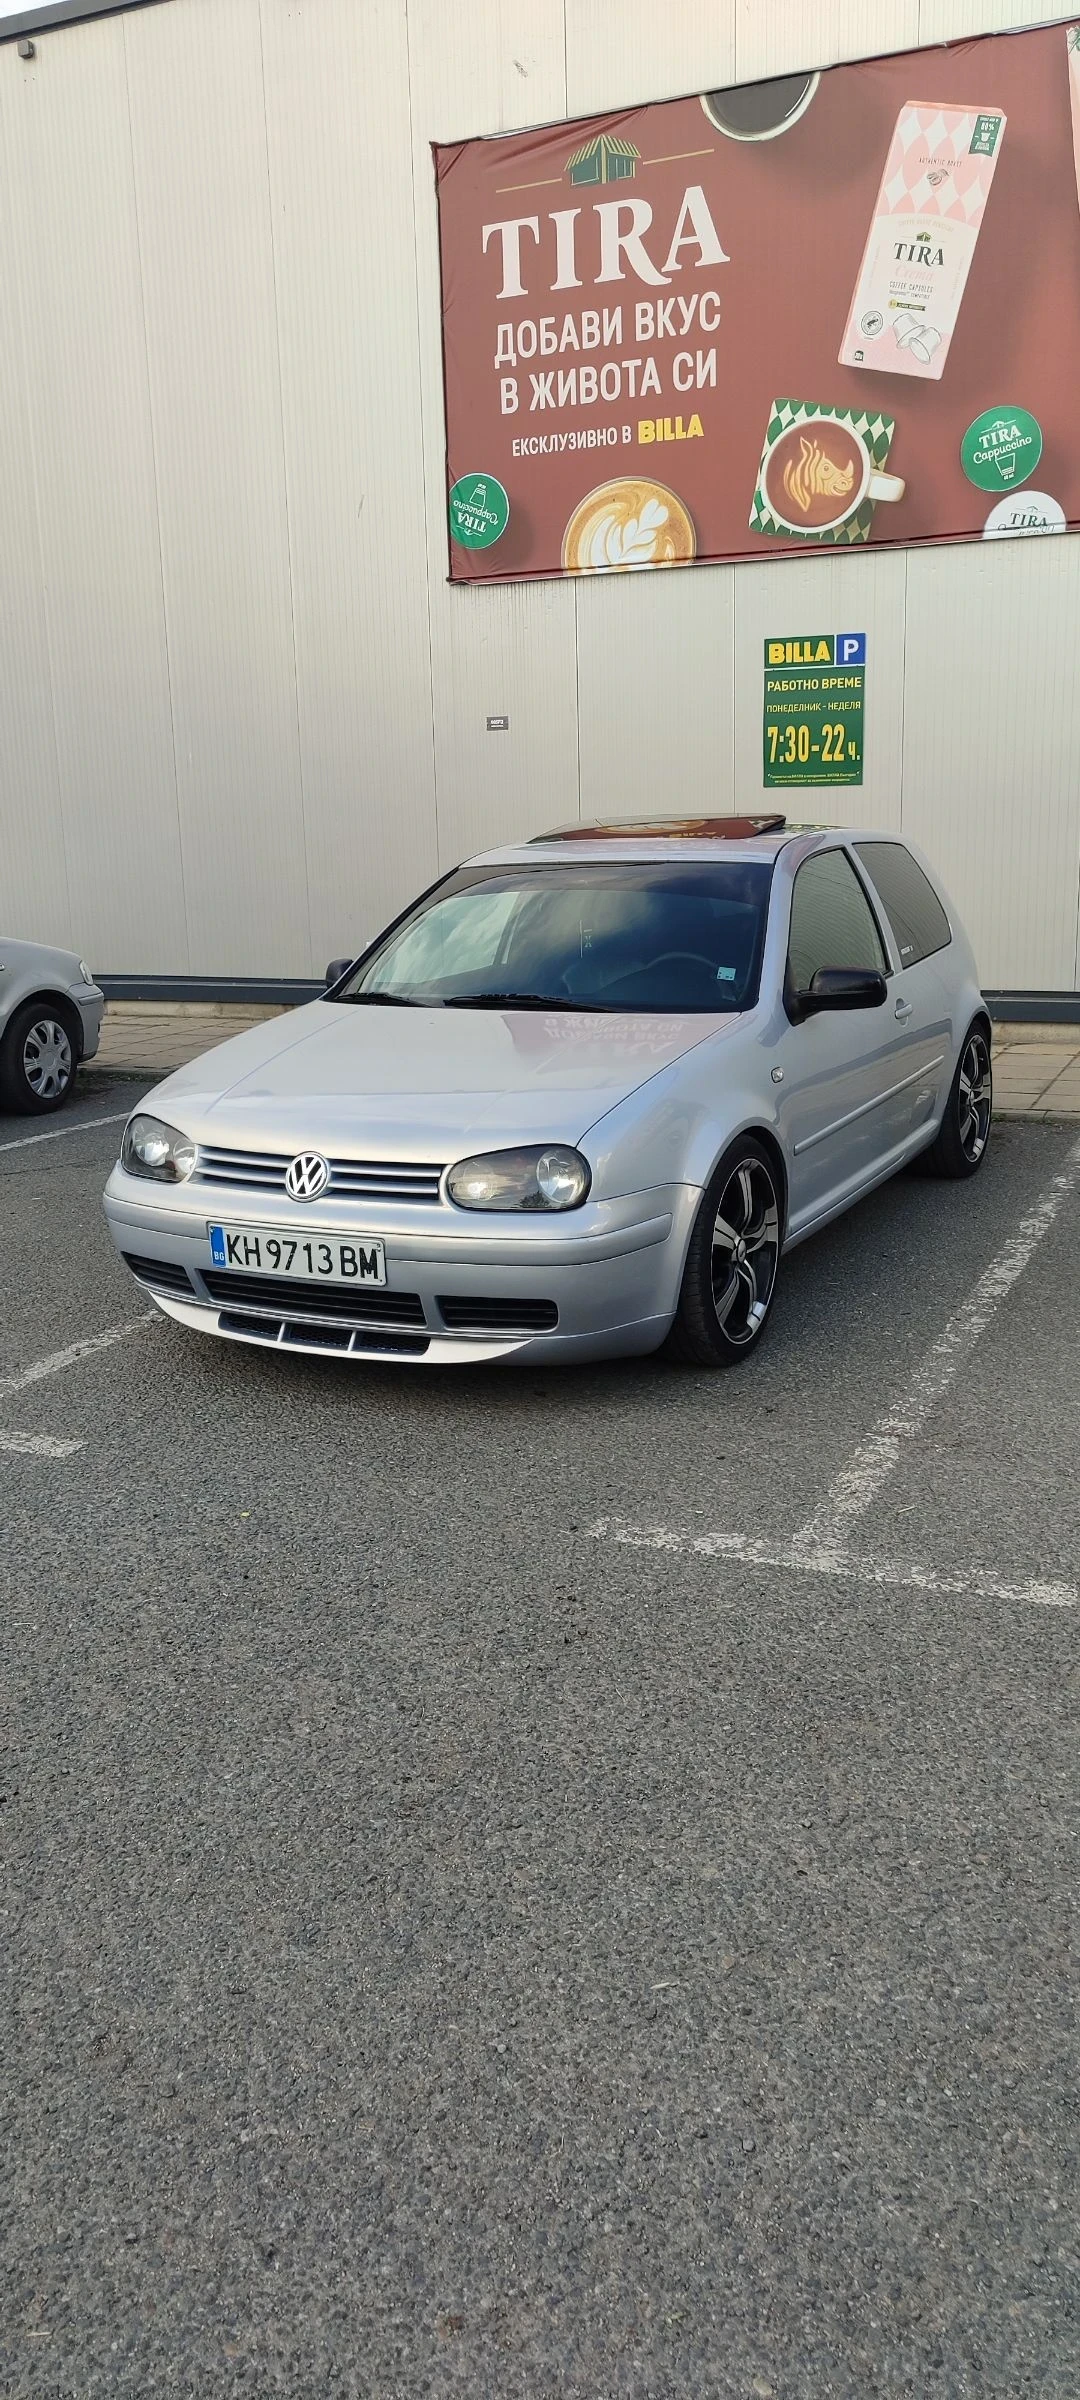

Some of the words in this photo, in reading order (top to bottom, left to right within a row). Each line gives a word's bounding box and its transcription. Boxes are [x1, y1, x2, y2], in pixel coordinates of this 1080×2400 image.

[481, 184, 731, 300] TIRA
[893, 242, 944, 267] TIRA
[494, 305, 623, 370] ДОБАВИ
[635, 290, 721, 342] ВКУС
[500, 377, 519, 415] В
[529, 356, 663, 411] ЖИВОТА
[672, 348, 717, 392] СИ
[512, 426, 618, 457] ЕКСКЛУЗИВНО
[621, 425, 632, 444] В
[637, 413, 705, 445] BILLA
[979, 424, 1022, 449] TIRA
[973, 436, 1032, 464] Cappuccino
[458, 511, 487, 533] TIRA
[1010, 512, 1048, 527] TIRA
[768, 640, 831, 664] BILLA
[843, 639, 859, 662] P
[767, 679, 819, 692] РАБОТНО
[821, 676, 862, 690] ВРЕМЕ
[766, 702, 822, 714] ПОНЕДЕЛНИК
[827, 701, 861, 712] НЕДЕЛЯ
[213, 1251, 225, 1261] BG
[226, 1233, 262, 1267] KH
[266, 1239, 333, 1275] 9713
[339, 1245, 379, 1280] BM
